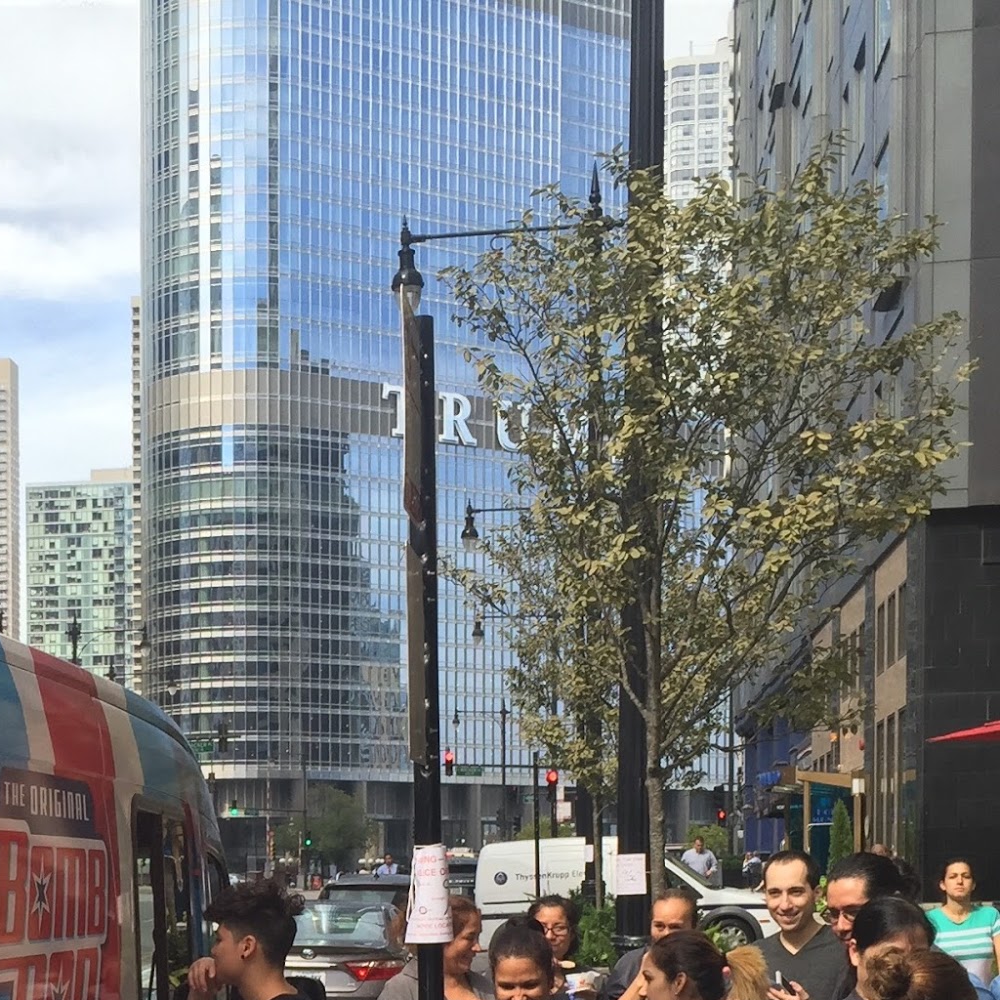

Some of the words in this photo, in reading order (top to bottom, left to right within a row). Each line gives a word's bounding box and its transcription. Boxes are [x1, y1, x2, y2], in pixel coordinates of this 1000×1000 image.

[4, 781, 26, 806] THE
[30, 785, 90, 821] ORIGINAL
[515, 871, 570, 881] ThysnKrupp
[571, 869, 585, 878] Ele
